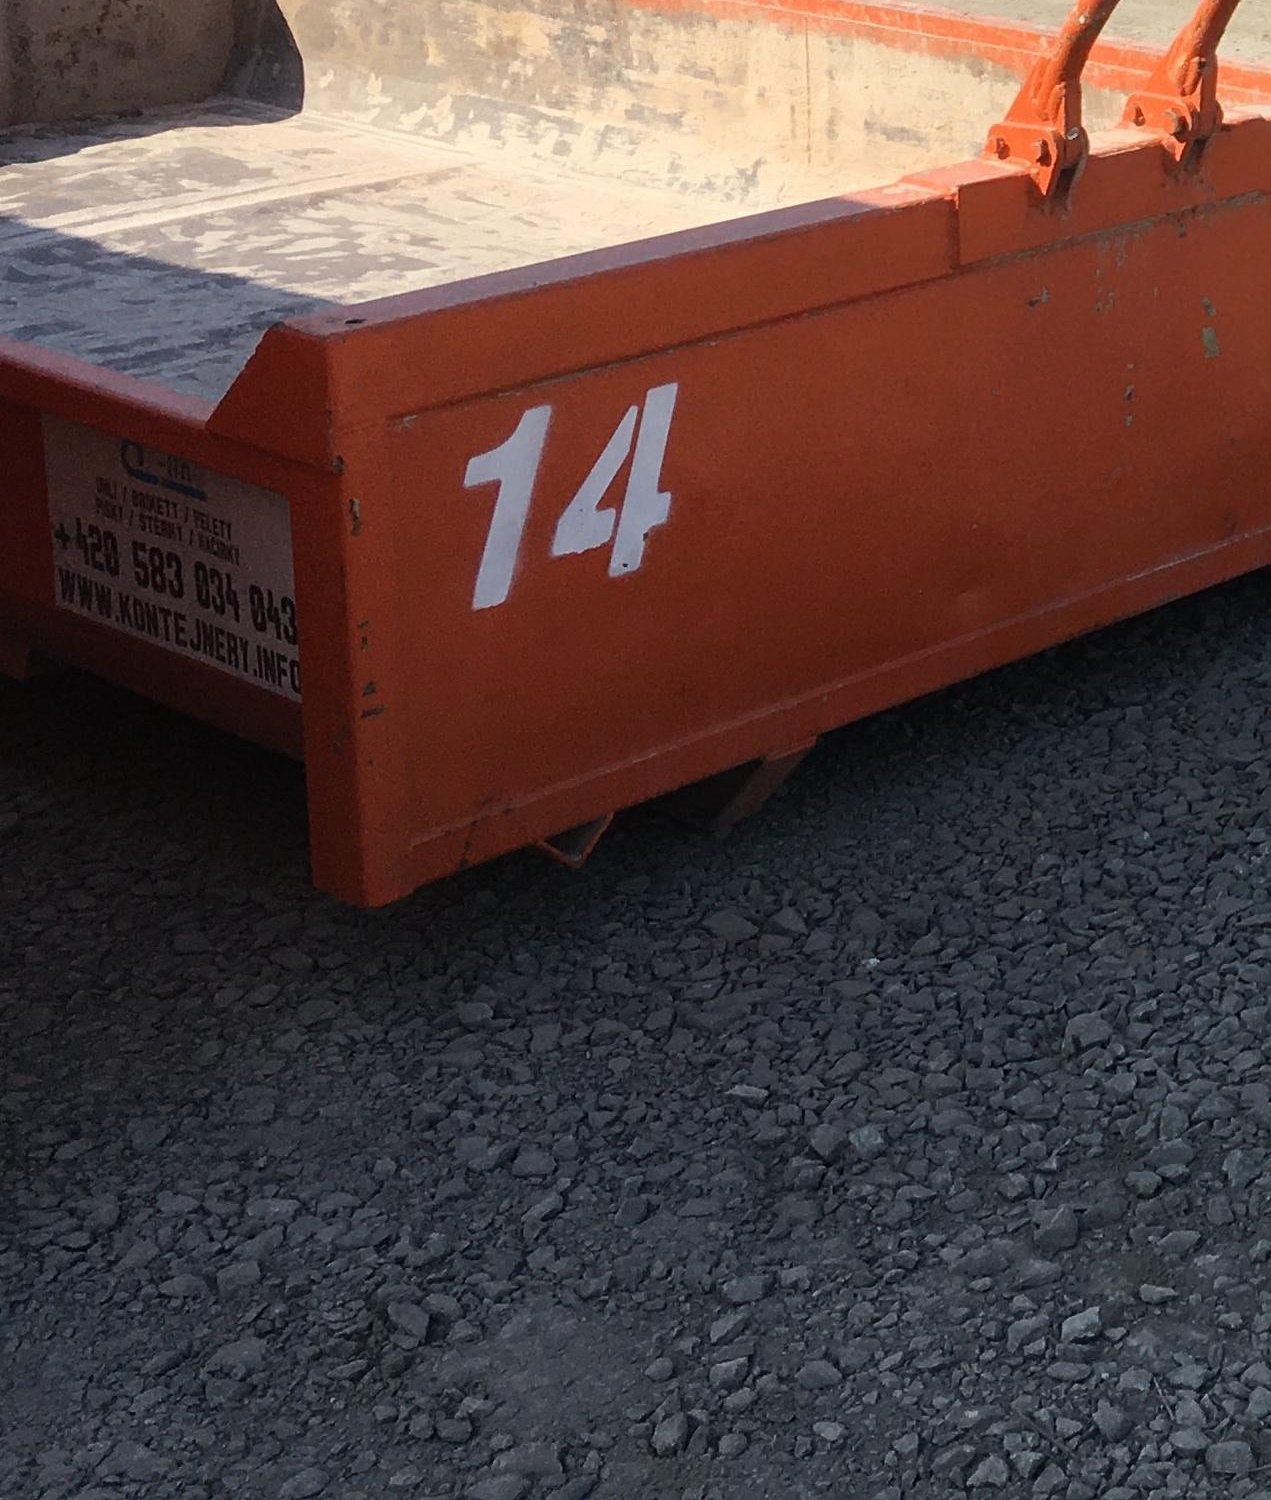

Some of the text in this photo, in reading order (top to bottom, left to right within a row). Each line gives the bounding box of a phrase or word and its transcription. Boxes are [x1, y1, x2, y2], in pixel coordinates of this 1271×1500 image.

[463, 382, 679, 611] 14
[132, 539, 185, 600] 583
[194, 560, 241, 624] 034
[249, 583, 299, 646] 043
